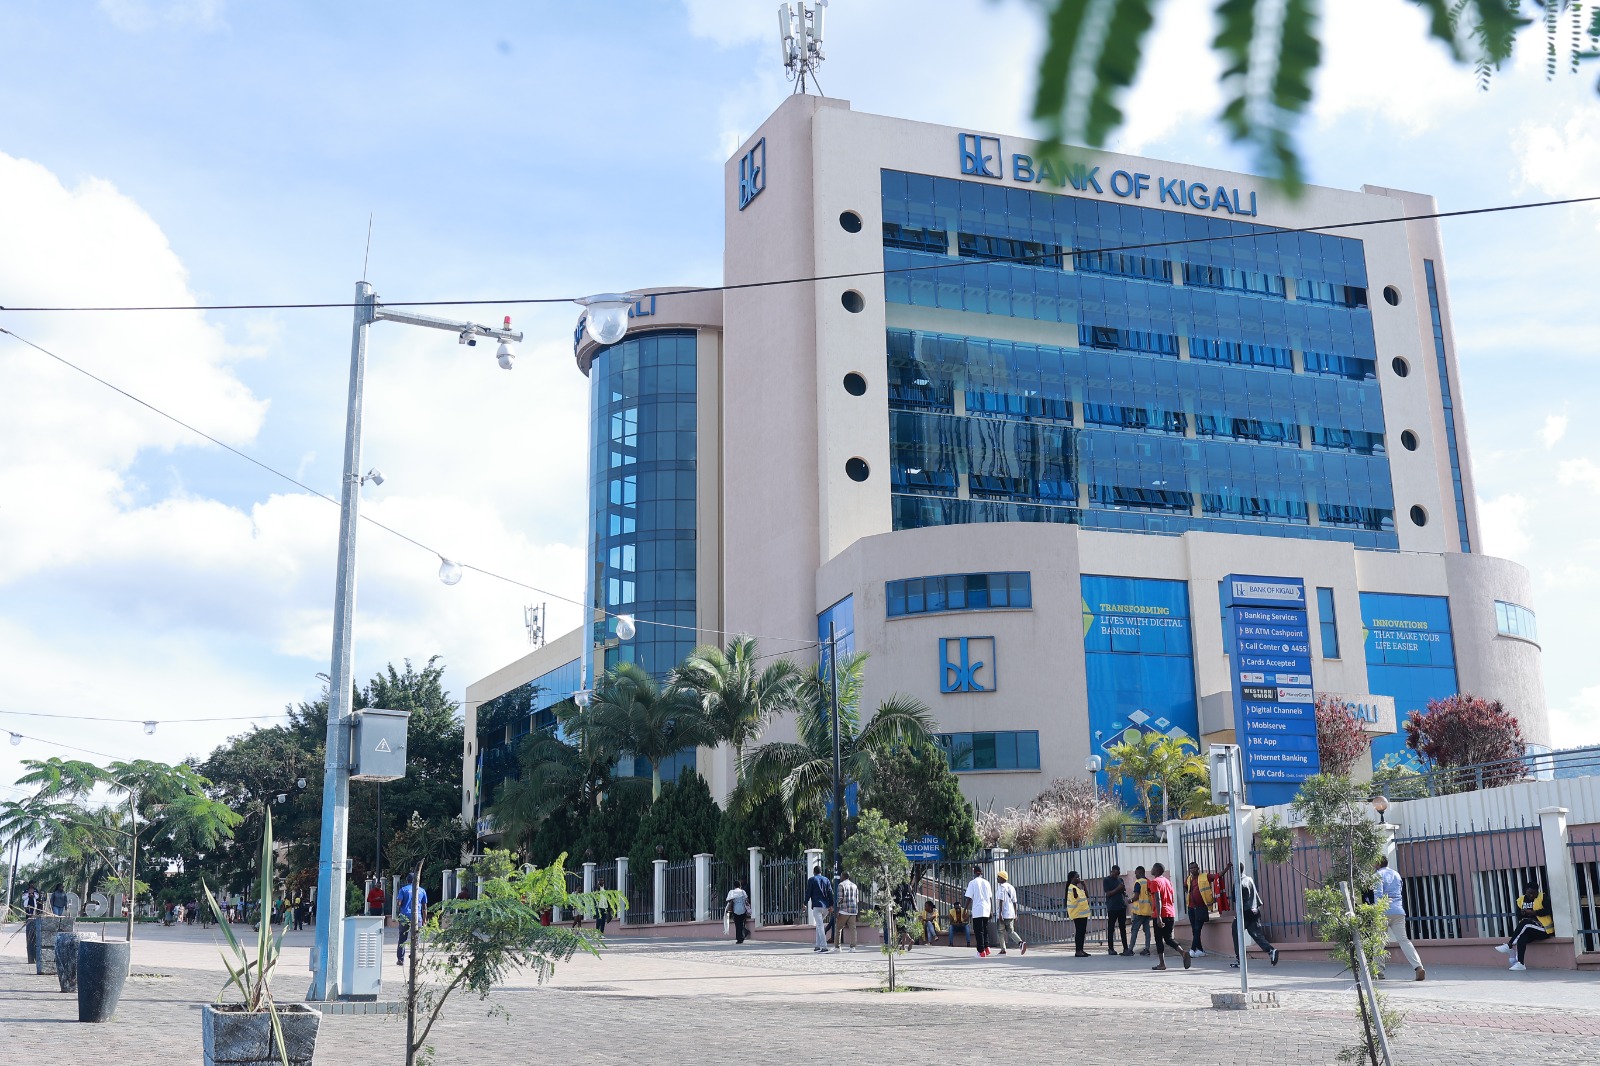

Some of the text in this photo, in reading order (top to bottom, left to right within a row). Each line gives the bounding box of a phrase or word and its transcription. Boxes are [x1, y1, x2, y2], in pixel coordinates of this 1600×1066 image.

[1012, 153, 1257, 217] BANK OF KIGALI
[1100, 604, 1169, 614] TRANSFORMING
[1244, 612, 1298, 621] Banking Services
[1100, 616, 1182, 628] LIVES WITH DIGITAL
[1373, 619, 1428, 629] INNOVATIONS
[1102, 626, 1140, 636] BANKING
[1271, 628, 1303, 638] Cashpoint
[1374, 631, 1440, 642] THAT MAKE YOUR
[1375, 642, 1418, 651] LIFE EASIER
[1246, 659, 1296, 668] Cards Accepted
[1251, 706, 1303, 714] Digital Channels
[1252, 722, 1286, 730] Mobiserve
[1264, 738, 1277, 746] App
[1282, 754, 1308, 763] Banking
[1266, 769, 1285, 777] Cards
